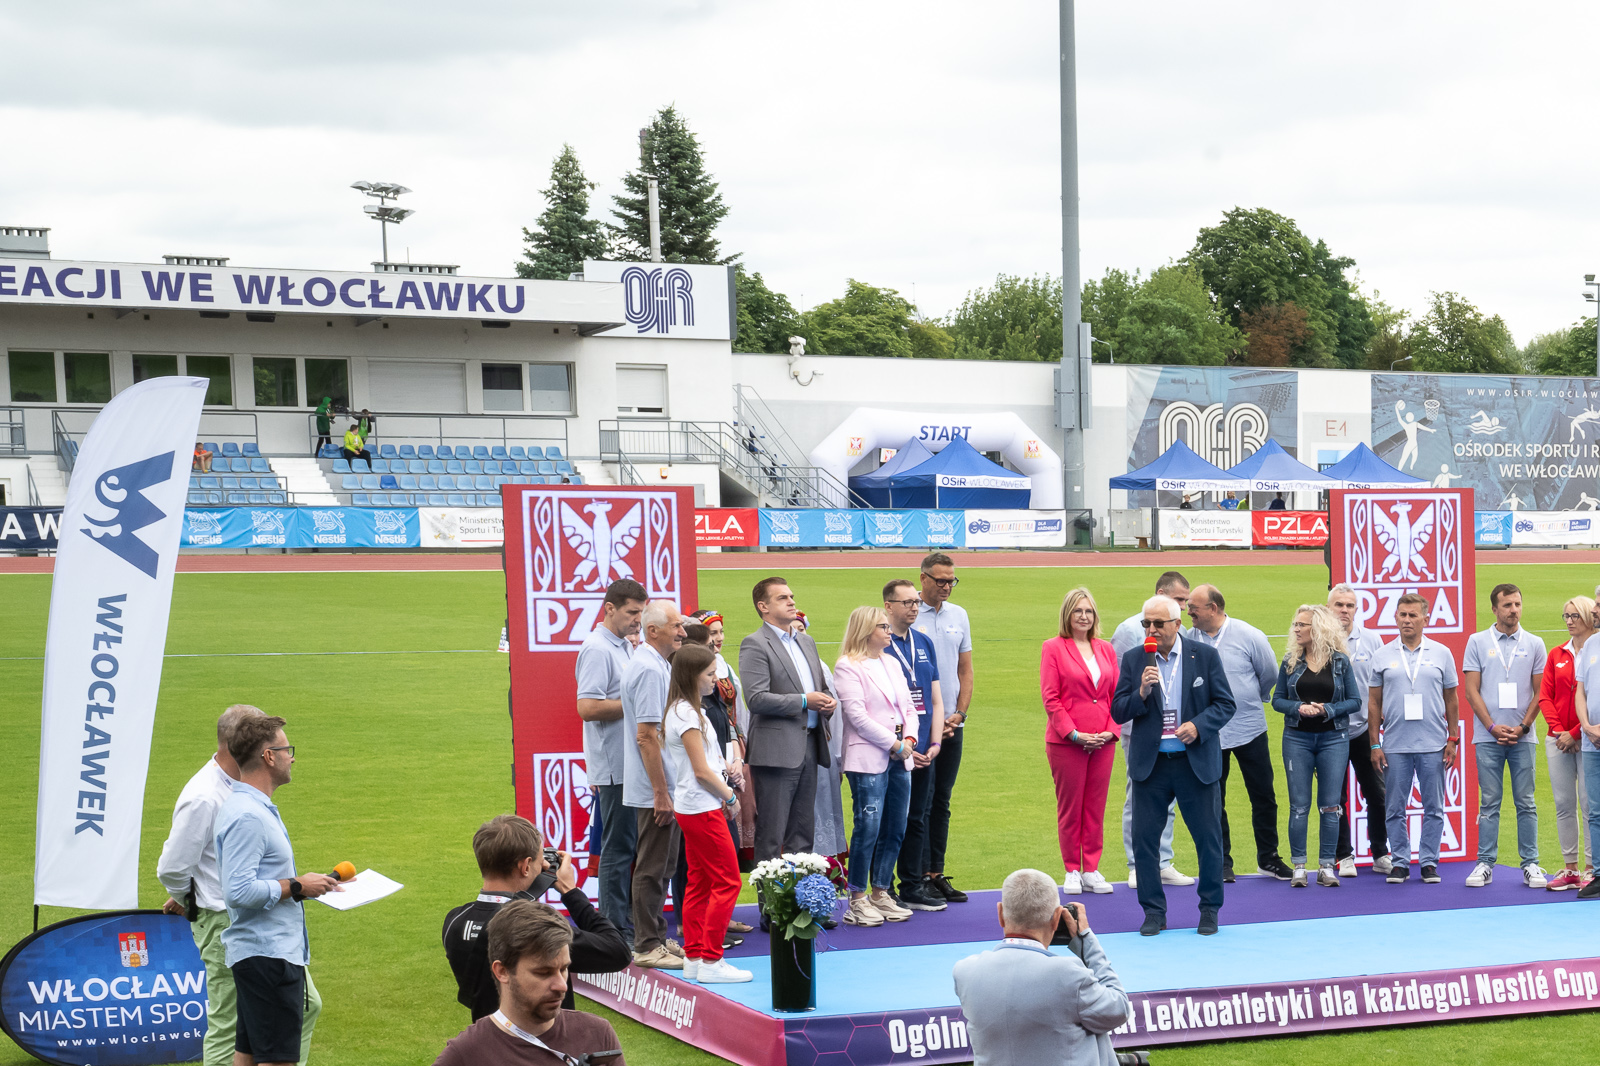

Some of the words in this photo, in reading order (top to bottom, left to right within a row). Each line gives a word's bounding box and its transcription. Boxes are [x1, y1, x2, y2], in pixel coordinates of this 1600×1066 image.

[142, 270, 215, 303] WE
[233, 274, 525, 314] WŁOCŁAWKU
[918, 425, 972, 442] START
[1325, 419, 1347, 436] E1
[1453, 441, 1522, 458] OŚRODEK
[1525, 444, 1581, 459] SPORTU
[1583, 445, 1588, 458] I
[1499, 463, 1522, 478] WE
[1, 512, 26, 541] A
[459, 526, 484, 535] Sportu
[1190, 527, 1212, 535] Sportu
[1217, 527, 1244, 535] Turystyki
[1263, 516, 1329, 534] PZLA
[188, 534, 223, 545] Nestlé
[252, 533, 286, 545] Nestlé
[313, 534, 347, 544] Nestlé
[374, 534, 407, 544] Nestlé
[770, 533, 800, 543] Nestlé
[824, 533, 853, 543] Nestlé
[1354, 587, 1457, 627] PZA
[74, 593, 128, 837] WŁOCŁAWEK
[27, 970, 206, 1005] WŁOCŁAW
[634, 973, 651, 1009] dla
[648, 980, 697, 1030] każdego!
[19, 1005, 144, 1032] MIASTEM
[888, 1015, 970, 1059] Ogóln
[1141, 986, 1315, 1033] Lekkoatletyki
[1320, 984, 1358, 1018] dla
[1362, 974, 1471, 1014] każdego!
[1474, 969, 1550, 1005] Nestlé
[1553, 966, 1599, 1001] Cup
